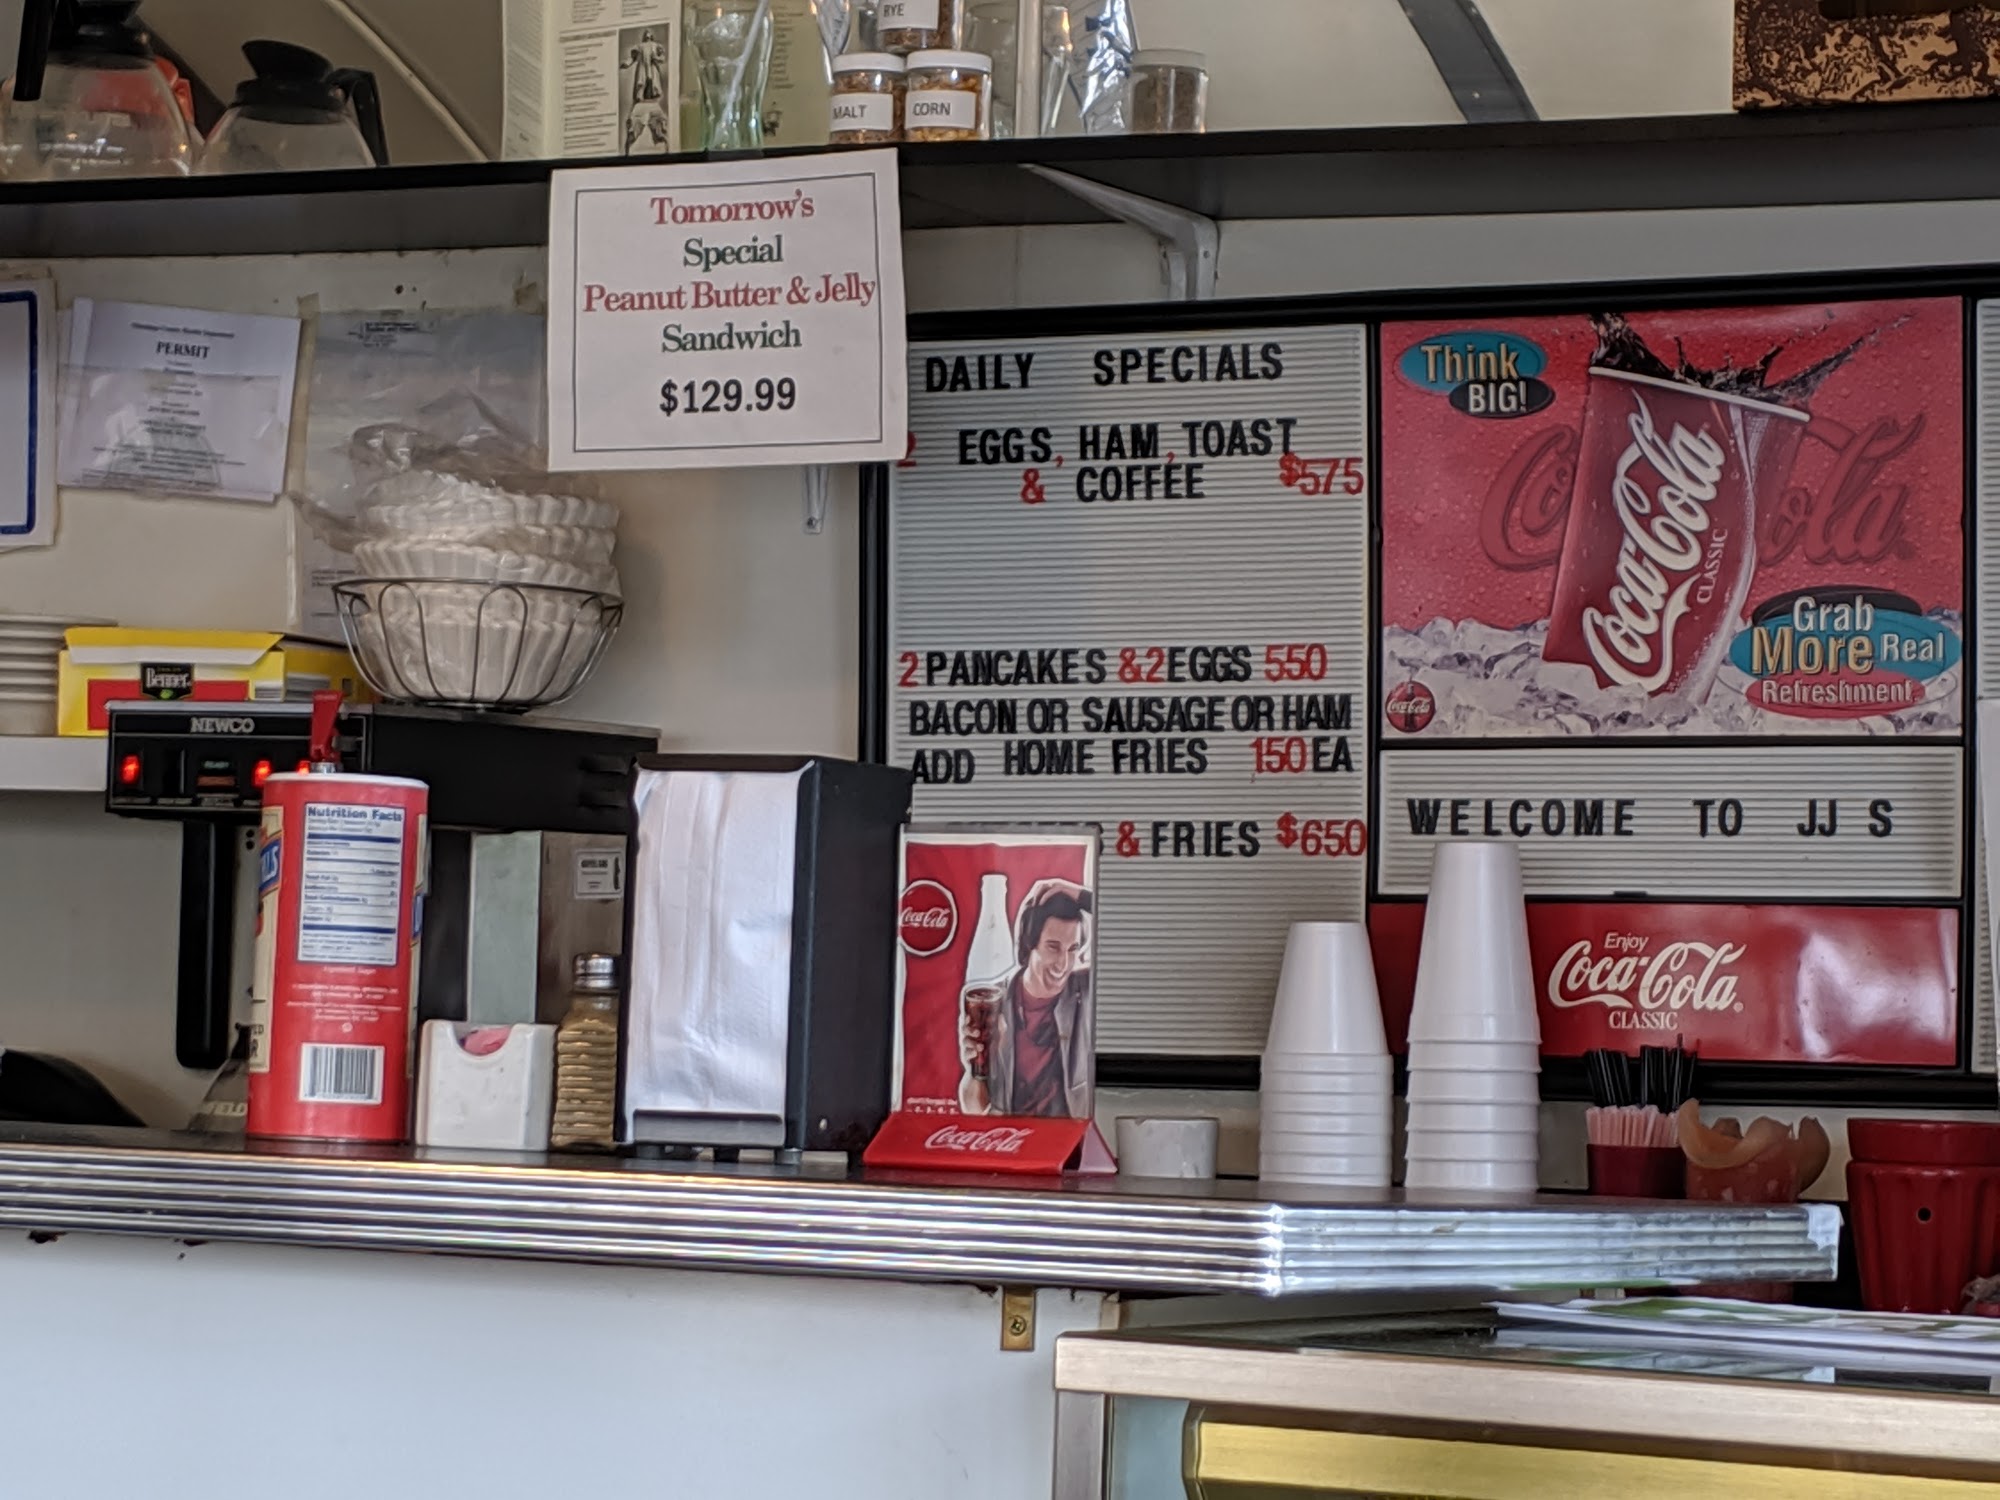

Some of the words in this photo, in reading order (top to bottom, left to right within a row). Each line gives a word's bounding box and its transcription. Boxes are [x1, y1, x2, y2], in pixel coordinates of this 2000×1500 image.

[883, 4, 905, 18] RYE
[832, 104, 867, 120] MALT
[912, 102, 952, 117] CORN
[650, 188, 815, 226] Tomorrow's
[683, 234, 784, 272] Special
[583, 284, 688, 312] Peanut
[691, 280, 782, 310] Butter
[786, 275, 810, 305] &
[815, 271, 877, 307] Jelly
[156, 341, 211, 359] PERMIT
[661, 320, 802, 353] Sandwich
[925, 353, 1035, 393] DAILY
[1093, 342, 1284, 386] SPECIALS
[1420, 342, 1519, 383] Think
[659, 377, 797, 417] $129.99
[1468, 380, 1527, 413] BIG!
[1181, 417, 1298, 457] TOAST
[1020, 468, 1046, 504] &
[1076, 463, 1205, 503] COFFEE
[1279, 451, 1364, 496] $575
[1582, 387, 1726, 692] Coca-Cola
[1696, 528, 1728, 604] CLASSIC
[1792, 595, 1875, 632] Grab
[899, 652, 919, 687] 2
[926, 647, 1107, 686] PANCAKES
[1264, 643, 1328, 682] 550
[1752, 625, 1874, 675] More
[1881, 631, 1944, 663] Real
[190, 717, 255, 733] NEWCO
[909, 699, 1018, 736] BACON
[1027, 698, 1069, 733] OR
[1082, 695, 1225, 732] SAUSAGE
[1231, 694, 1275, 731] OR
[1281, 693, 1353, 731] HAM
[912, 749, 976, 784] ADD
[1003, 739, 1096, 776] HOME
[1112, 737, 1209, 775] FRIES
[1249, 736, 1307, 774] 150
[1312, 736, 1354, 773] EA
[308, 807, 368, 819] Nutrition
[372, 808, 403, 822] Facts
[1407, 798, 1637, 838] WELCOME
[1693, 797, 1744, 837] TO
[1797, 797, 1838, 837] JJ
[1868, 798, 1894, 838] S
[1116, 820, 1141, 858] &
[1151, 820, 1260, 858] FRIES
[1274, 811, 1368, 857] $650
[900, 907, 950, 928] Coca-Cola
[1604, 932, 1650, 953] Enjoy
[1548, 940, 1748, 1012] Coca-Cola
[1609, 1011, 1678, 1031] CLASSIC
[924, 1124, 1035, 1153] Coca-Cola
